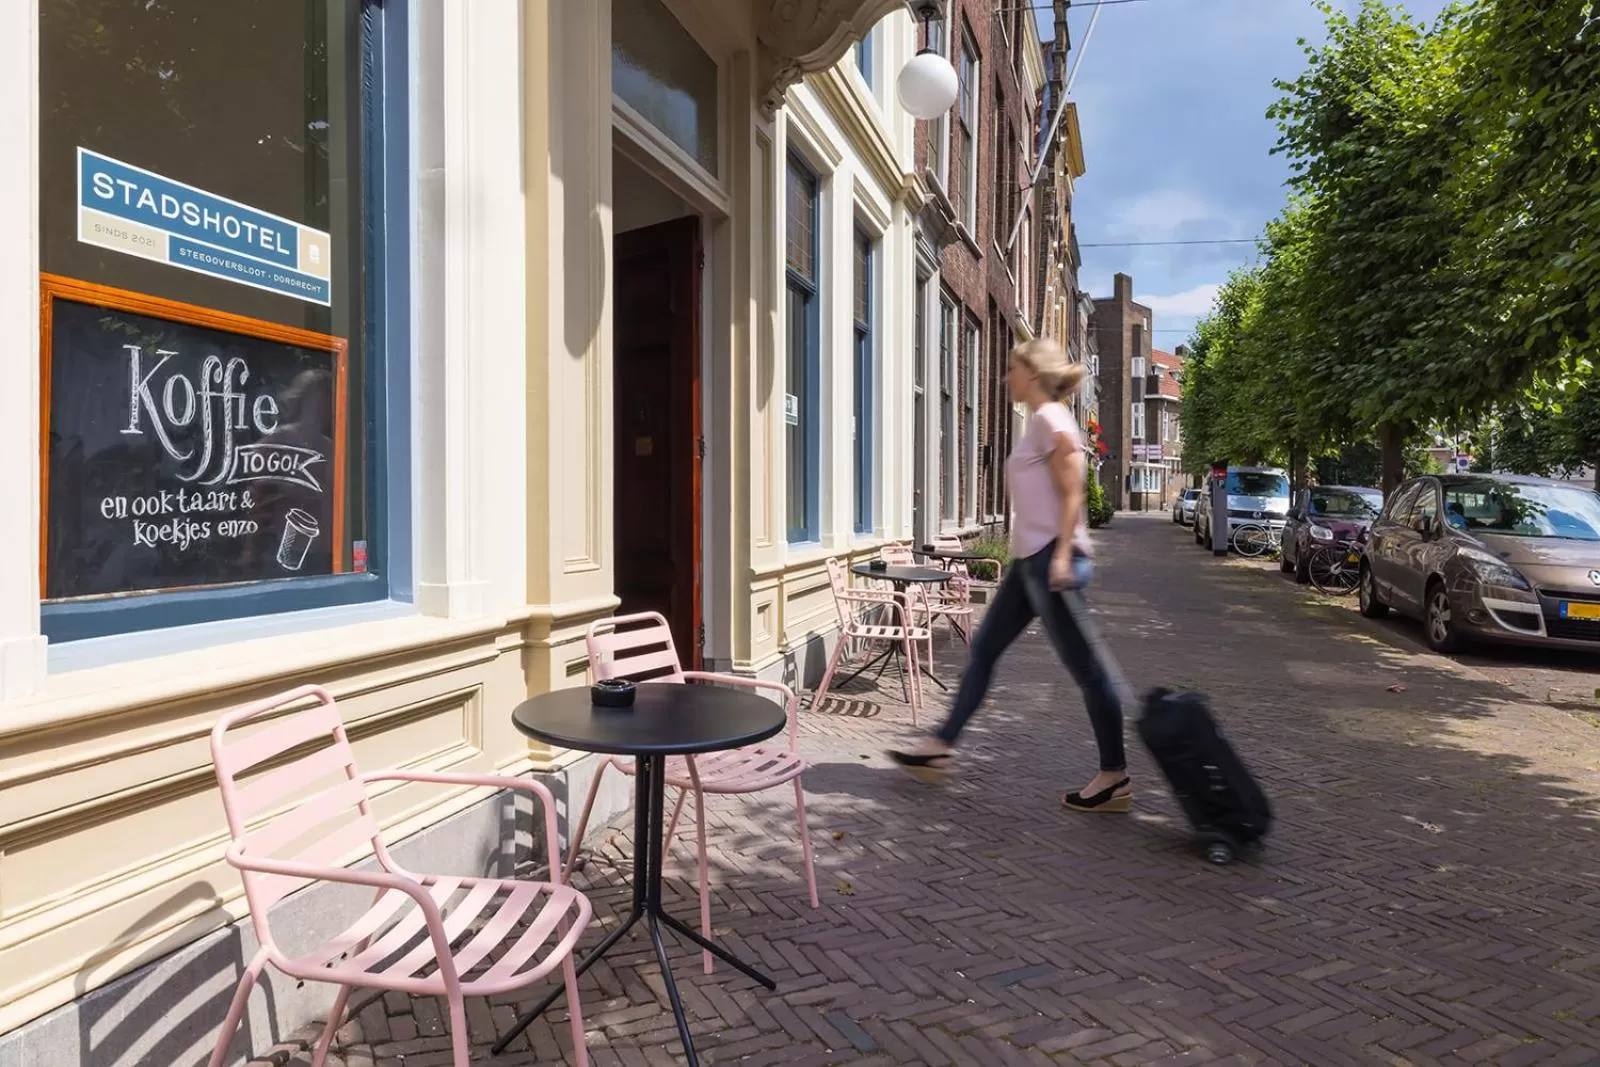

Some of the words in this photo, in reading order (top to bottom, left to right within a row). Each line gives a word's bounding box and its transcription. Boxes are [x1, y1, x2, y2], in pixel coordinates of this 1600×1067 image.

[93, 172, 290, 255] STADSHOTEL
[94, 223, 129, 240] SINDS
[131, 234, 156, 248] 2021
[179, 247, 266, 278] STEEGOVERSLOOT
[273, 274, 321, 293] DORDRECHT
[120, 344, 279, 484] Koffie
[100, 496, 128, 519] en
[131, 490, 174, 516] ook
[177, 488, 237, 514] taart
[240, 490, 255, 509] &
[217, 520, 258, 538] enzo
